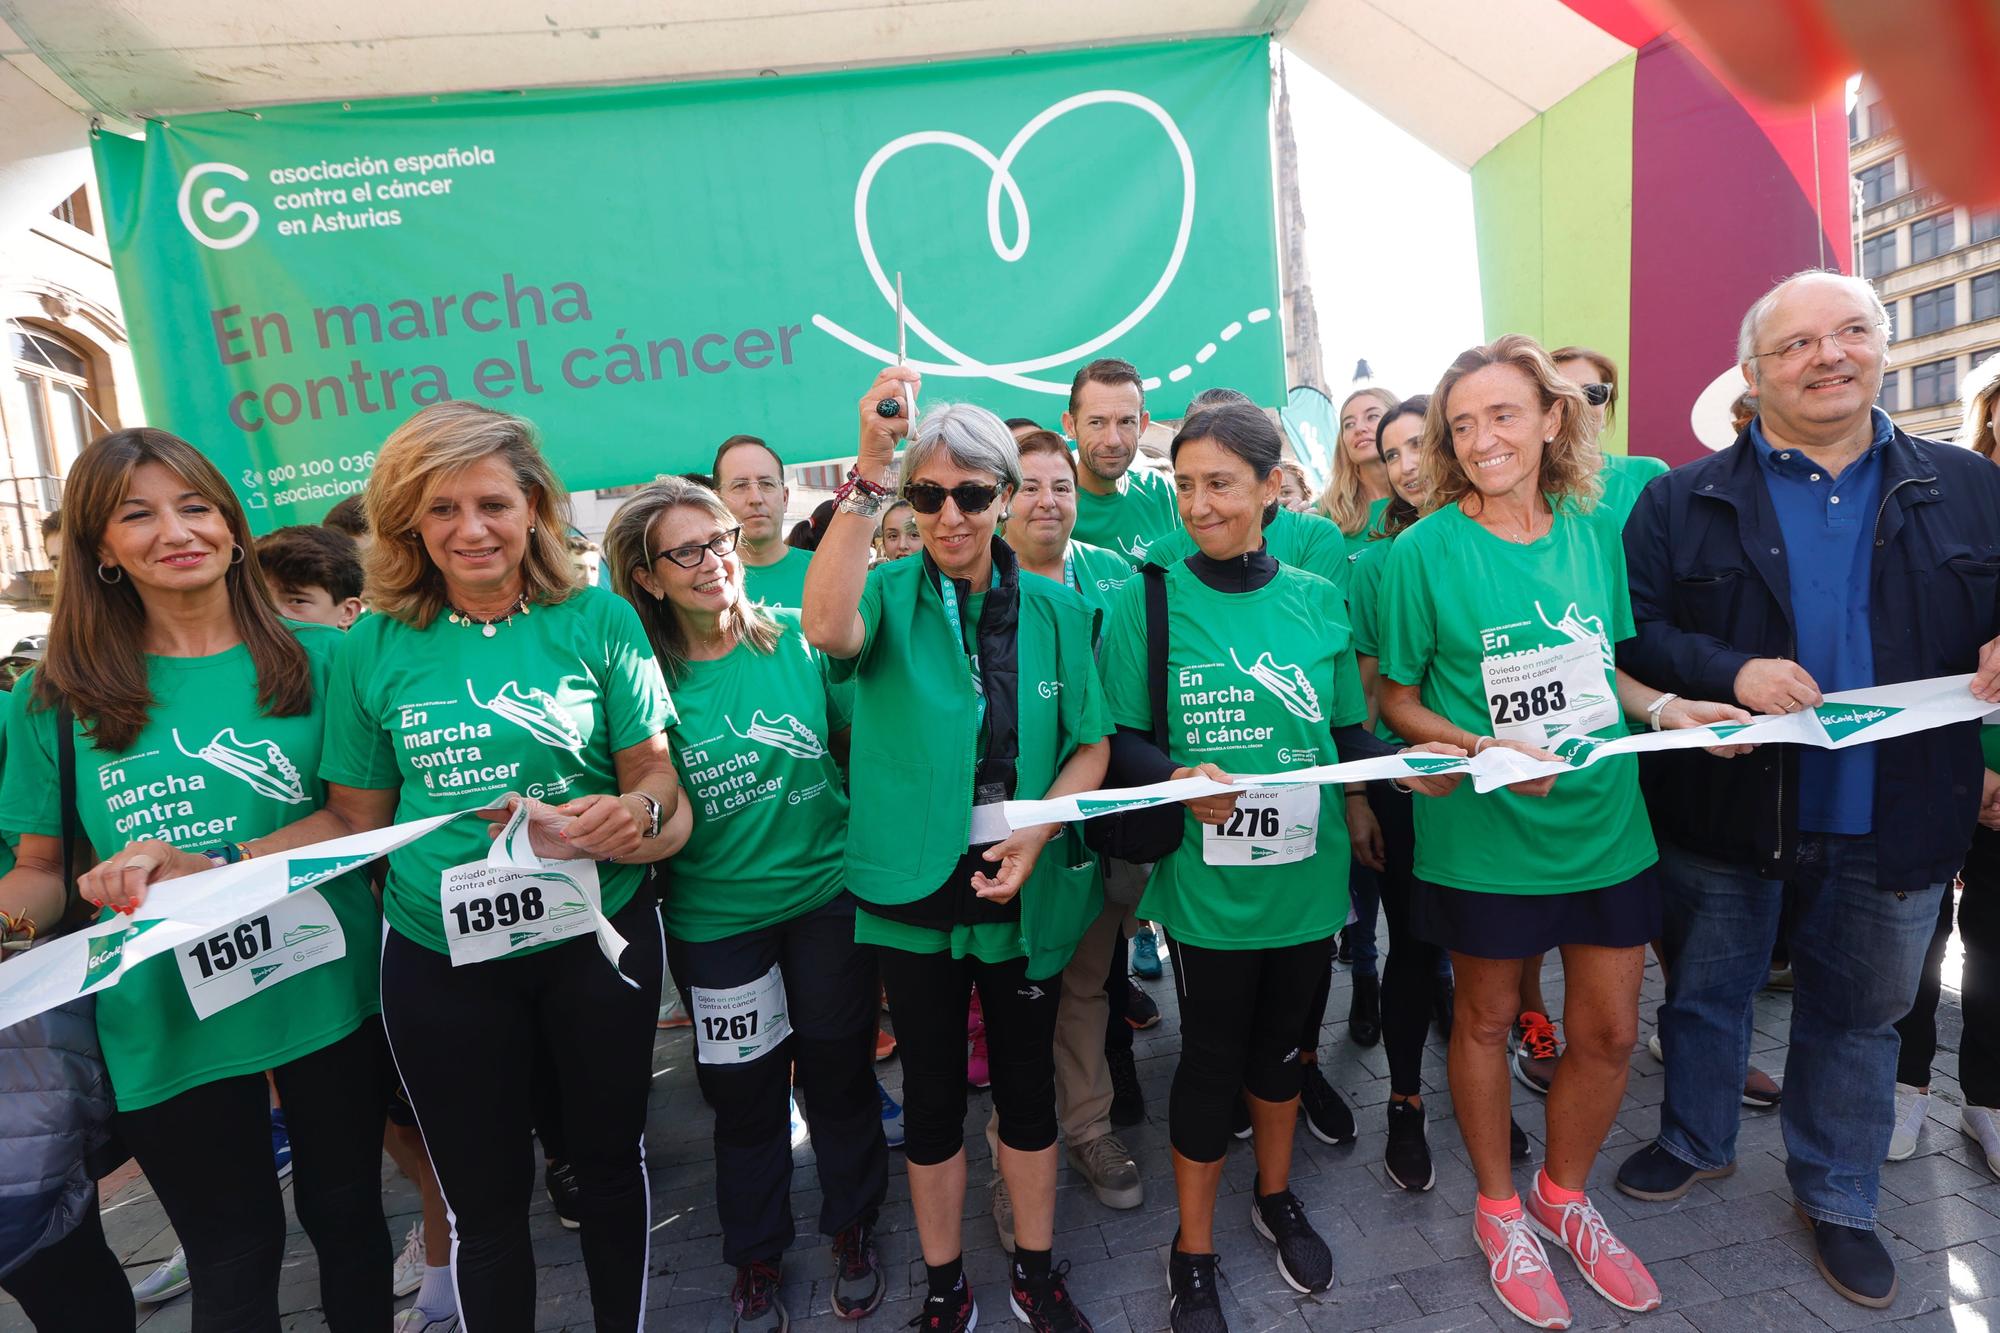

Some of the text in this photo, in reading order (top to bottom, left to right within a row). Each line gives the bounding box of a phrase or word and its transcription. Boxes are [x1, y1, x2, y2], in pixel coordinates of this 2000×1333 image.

[269, 145, 495, 185] asociación española
[273, 176, 452, 210] contra el cáncer
[277, 207, 402, 236] en Asturias
[210, 272, 593, 366] En marcha
[228, 322, 802, 433] contra el cáncer
[268, 451, 376, 487] 900 100 036
[1482, 632, 1510, 651] En
[1489, 664, 1521, 676] Oviedo
[1523, 663, 1535, 671] en
[1535, 653, 1564, 669] marcha
[1179, 671, 1203, 687] En
[1490, 673, 1520, 686] contra
[1522, 671, 1531, 681] el
[1180, 685, 1255, 706] marcha
[1490, 681, 1567, 725] 2383
[401, 709, 428, 729] En
[1183, 707, 1246, 725] contra
[403, 722, 492, 750] marcha
[1186, 726, 1274, 744] el cáncer
[410, 746, 482, 769] contra
[682, 750, 709, 768] En
[689, 750, 760, 785] marcha
[99, 768, 126, 791] En
[424, 762, 520, 789] el cáncer
[697, 771, 757, 799] contra
[106, 775, 206, 813] marcha
[705, 800, 719, 815] el
[723, 776, 783, 809] cáncer
[1240, 791, 1247, 799] el
[116, 800, 194, 834] contra
[449, 880, 485, 892] contra
[487, 877, 497, 886] el
[450, 869, 486, 883] Oviedo
[450, 886, 545, 935] 1398
[189, 915, 273, 979] 1567
[698, 996, 716, 1004] Gijón
[728, 990, 757, 1002] marcha
[732, 997, 757, 1009] cáncer
[701, 1010, 758, 1041] 1267
